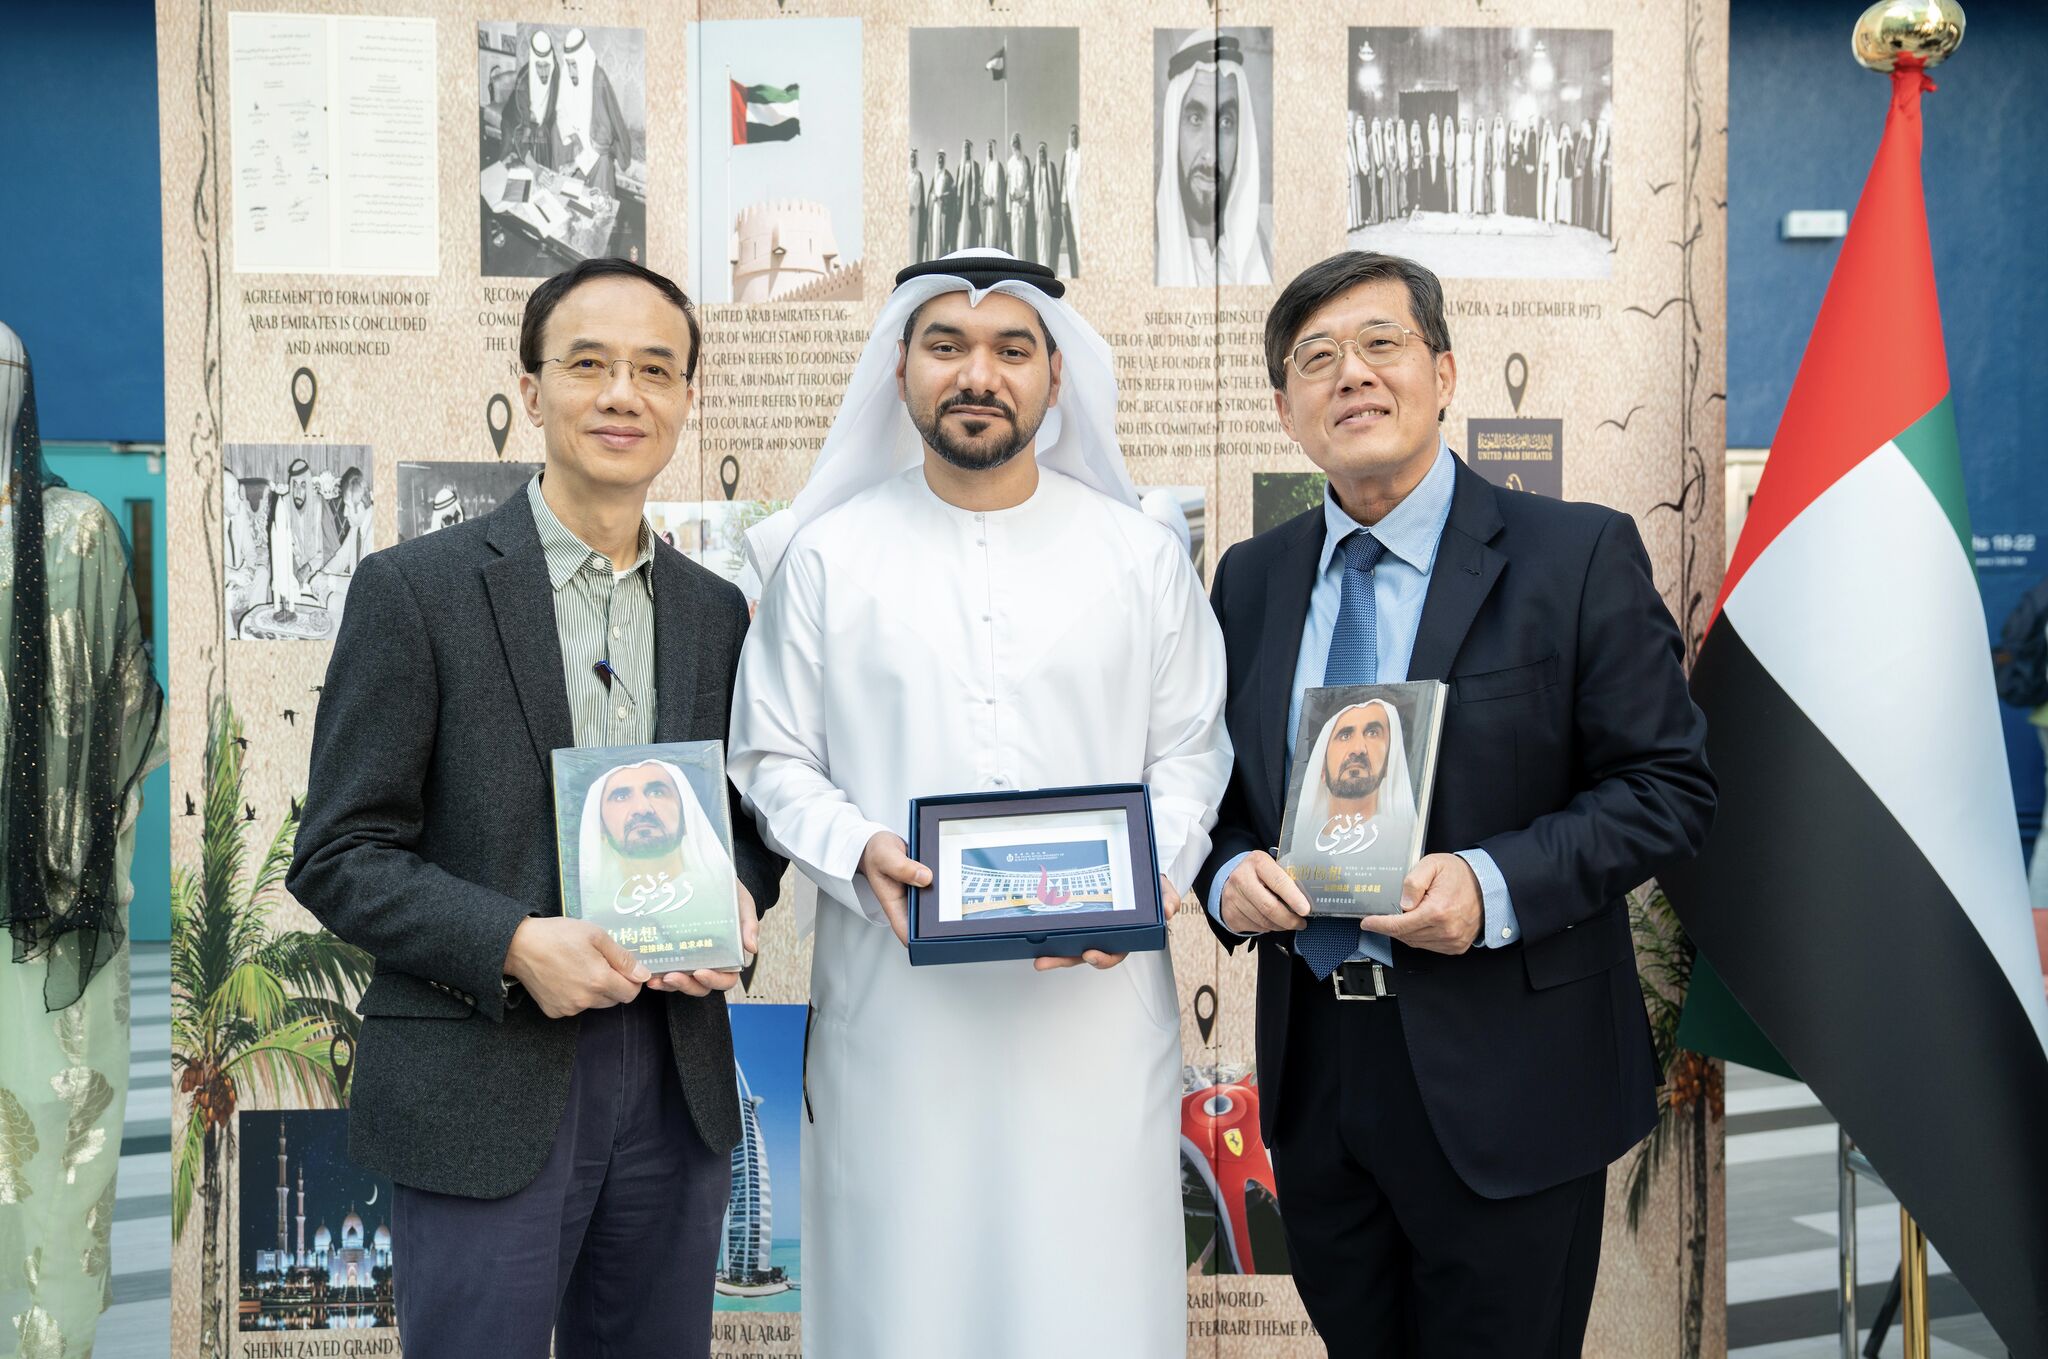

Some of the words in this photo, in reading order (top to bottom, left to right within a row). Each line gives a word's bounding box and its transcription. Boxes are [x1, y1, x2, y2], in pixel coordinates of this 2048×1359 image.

[244, 290, 314, 305] AGREEMENT
[319, 290, 333, 305] TO
[337, 291, 369, 305] FORM
[372, 292, 412, 306] UNION
[415, 292, 431, 306] OF
[705, 310, 743, 323] UNITED
[746, 309, 771, 325] ARAB
[773, 309, 820, 323] EMIRATES
[1144, 312, 1182, 325] SHEIKH
[1219, 311, 1237, 323] BIN
[1496, 303, 1508, 318] 24
[1512, 302, 1575, 317] DECEMBER
[1579, 305, 1602, 320] 1973
[249, 314, 278, 332] ARAB
[281, 314, 337, 330] EMIRATES
[340, 314, 350, 330] IS
[353, 316, 427, 331] CONCLUDED
[484, 337, 507, 351] THE
[727, 331, 740, 344] OF
[742, 331, 776, 344] WHICH
[778, 331, 811, 344] STAND
[814, 331, 833, 344] FOR
[1130, 334, 1144, 346] OF
[1146, 334, 1165, 349] ABU
[1168, 334, 1200, 346] DHABI
[1228, 333, 1248, 345] THE
[286, 341, 311, 355] AND
[315, 341, 390, 356] ANNOUNCED
[712, 352, 745, 368] GREEN
[748, 352, 783, 365] REFERS
[786, 352, 799, 365] TO
[801, 351, 856, 364] GOODNESS
[1117, 356, 1136, 369] THE
[1161, 356, 1210, 369] FOUNDER
[1228, 354, 1248, 367] THE
[740, 373, 795, 386] ABUNDANT
[1144, 378, 1174, 391] REFER
[1177, 378, 1192, 391] TO
[1194, 378, 1214, 391] HIM
[728, 394, 759, 409] WHITE
[762, 395, 797, 407] REFERS
[800, 395, 813, 407] TO
[1143, 400, 1188, 413] BECAUSE
[1190, 400, 1204, 413] OF
[1225, 399, 1267, 411] STRONG
[705, 417, 718, 429] TO
[720, 416, 768, 429] COURAGE
[771, 416, 792, 429] AND
[1136, 422, 1153, 435] HIS
[1155, 422, 1225, 435] COMMITMENT
[1228, 420, 1242, 433] TO
[730, 438, 763, 450] POWER
[765, 438, 787, 450] AND
[1170, 443, 1192, 457] AND
[1195, 443, 1210, 457] HIS
[1478, 451, 1502, 460] UNITED
[1503, 451, 1520, 460] ARAB
[1521, 451, 1553, 460] EMIRATES
[740, 1324, 755, 1345] AL
[1199, 1320, 1250, 1336] FERRARI
[1255, 1320, 1298, 1336] THEME
[243, 1341, 293, 1359] SHEIKH
[297, 1340, 340, 1359] ZAYED
[343, 1338, 393, 1358] GRAND
